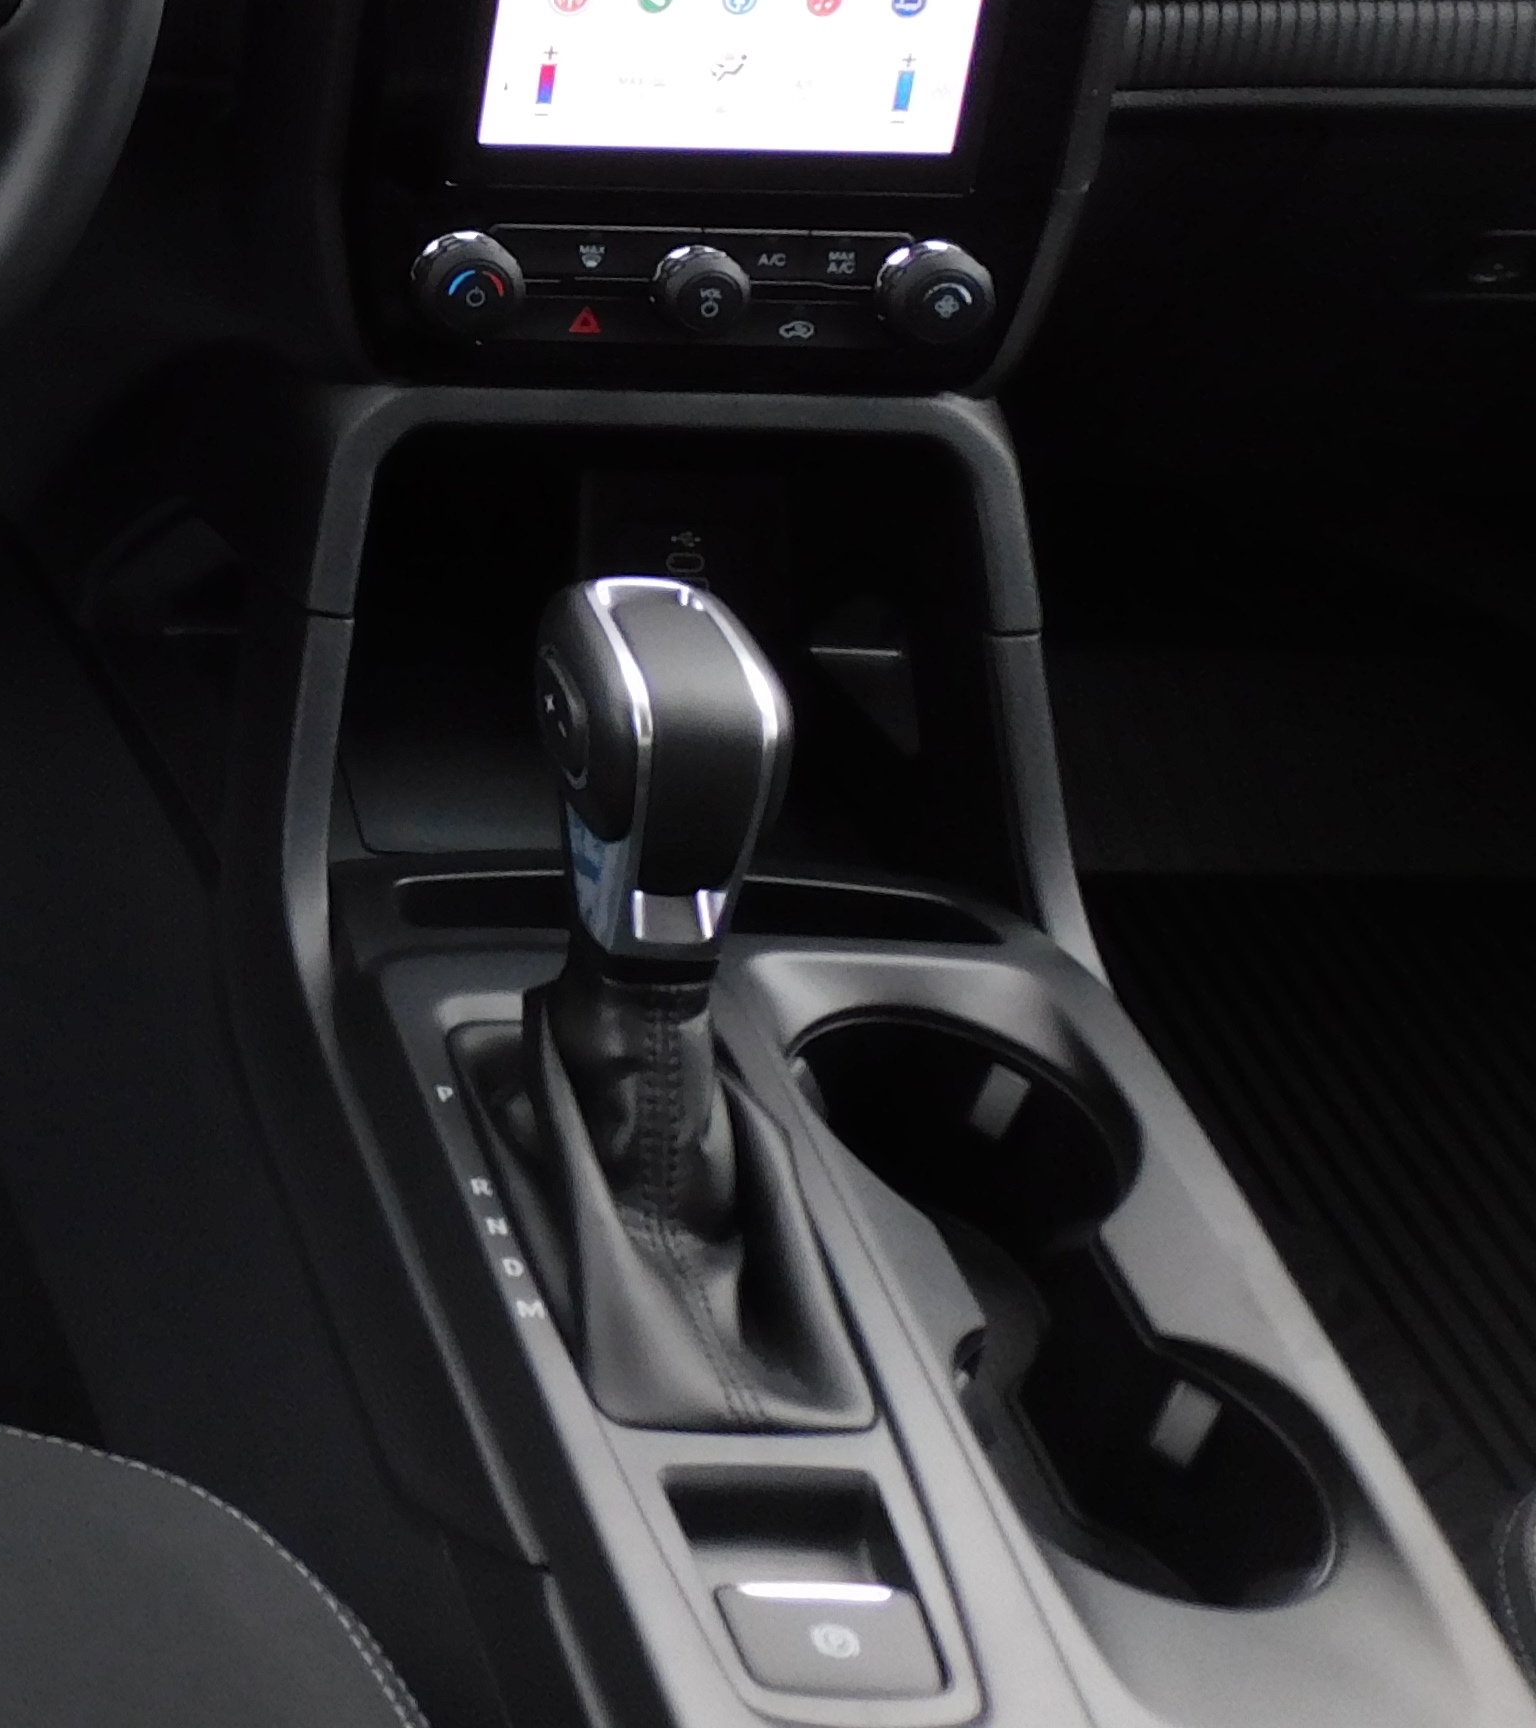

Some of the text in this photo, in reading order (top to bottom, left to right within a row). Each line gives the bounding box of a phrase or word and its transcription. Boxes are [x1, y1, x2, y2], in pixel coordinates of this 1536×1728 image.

[579, 245, 606, 255] MAX
[757, 253, 786, 267] A/C
[699, 288, 722, 300] VOL
[435, 1084, 454, 1103] P
[470, 1177, 494, 1197] R
[485, 1217, 509, 1235] N
[502, 1257, 525, 1278] D
[515, 1299, 546, 1319] M
